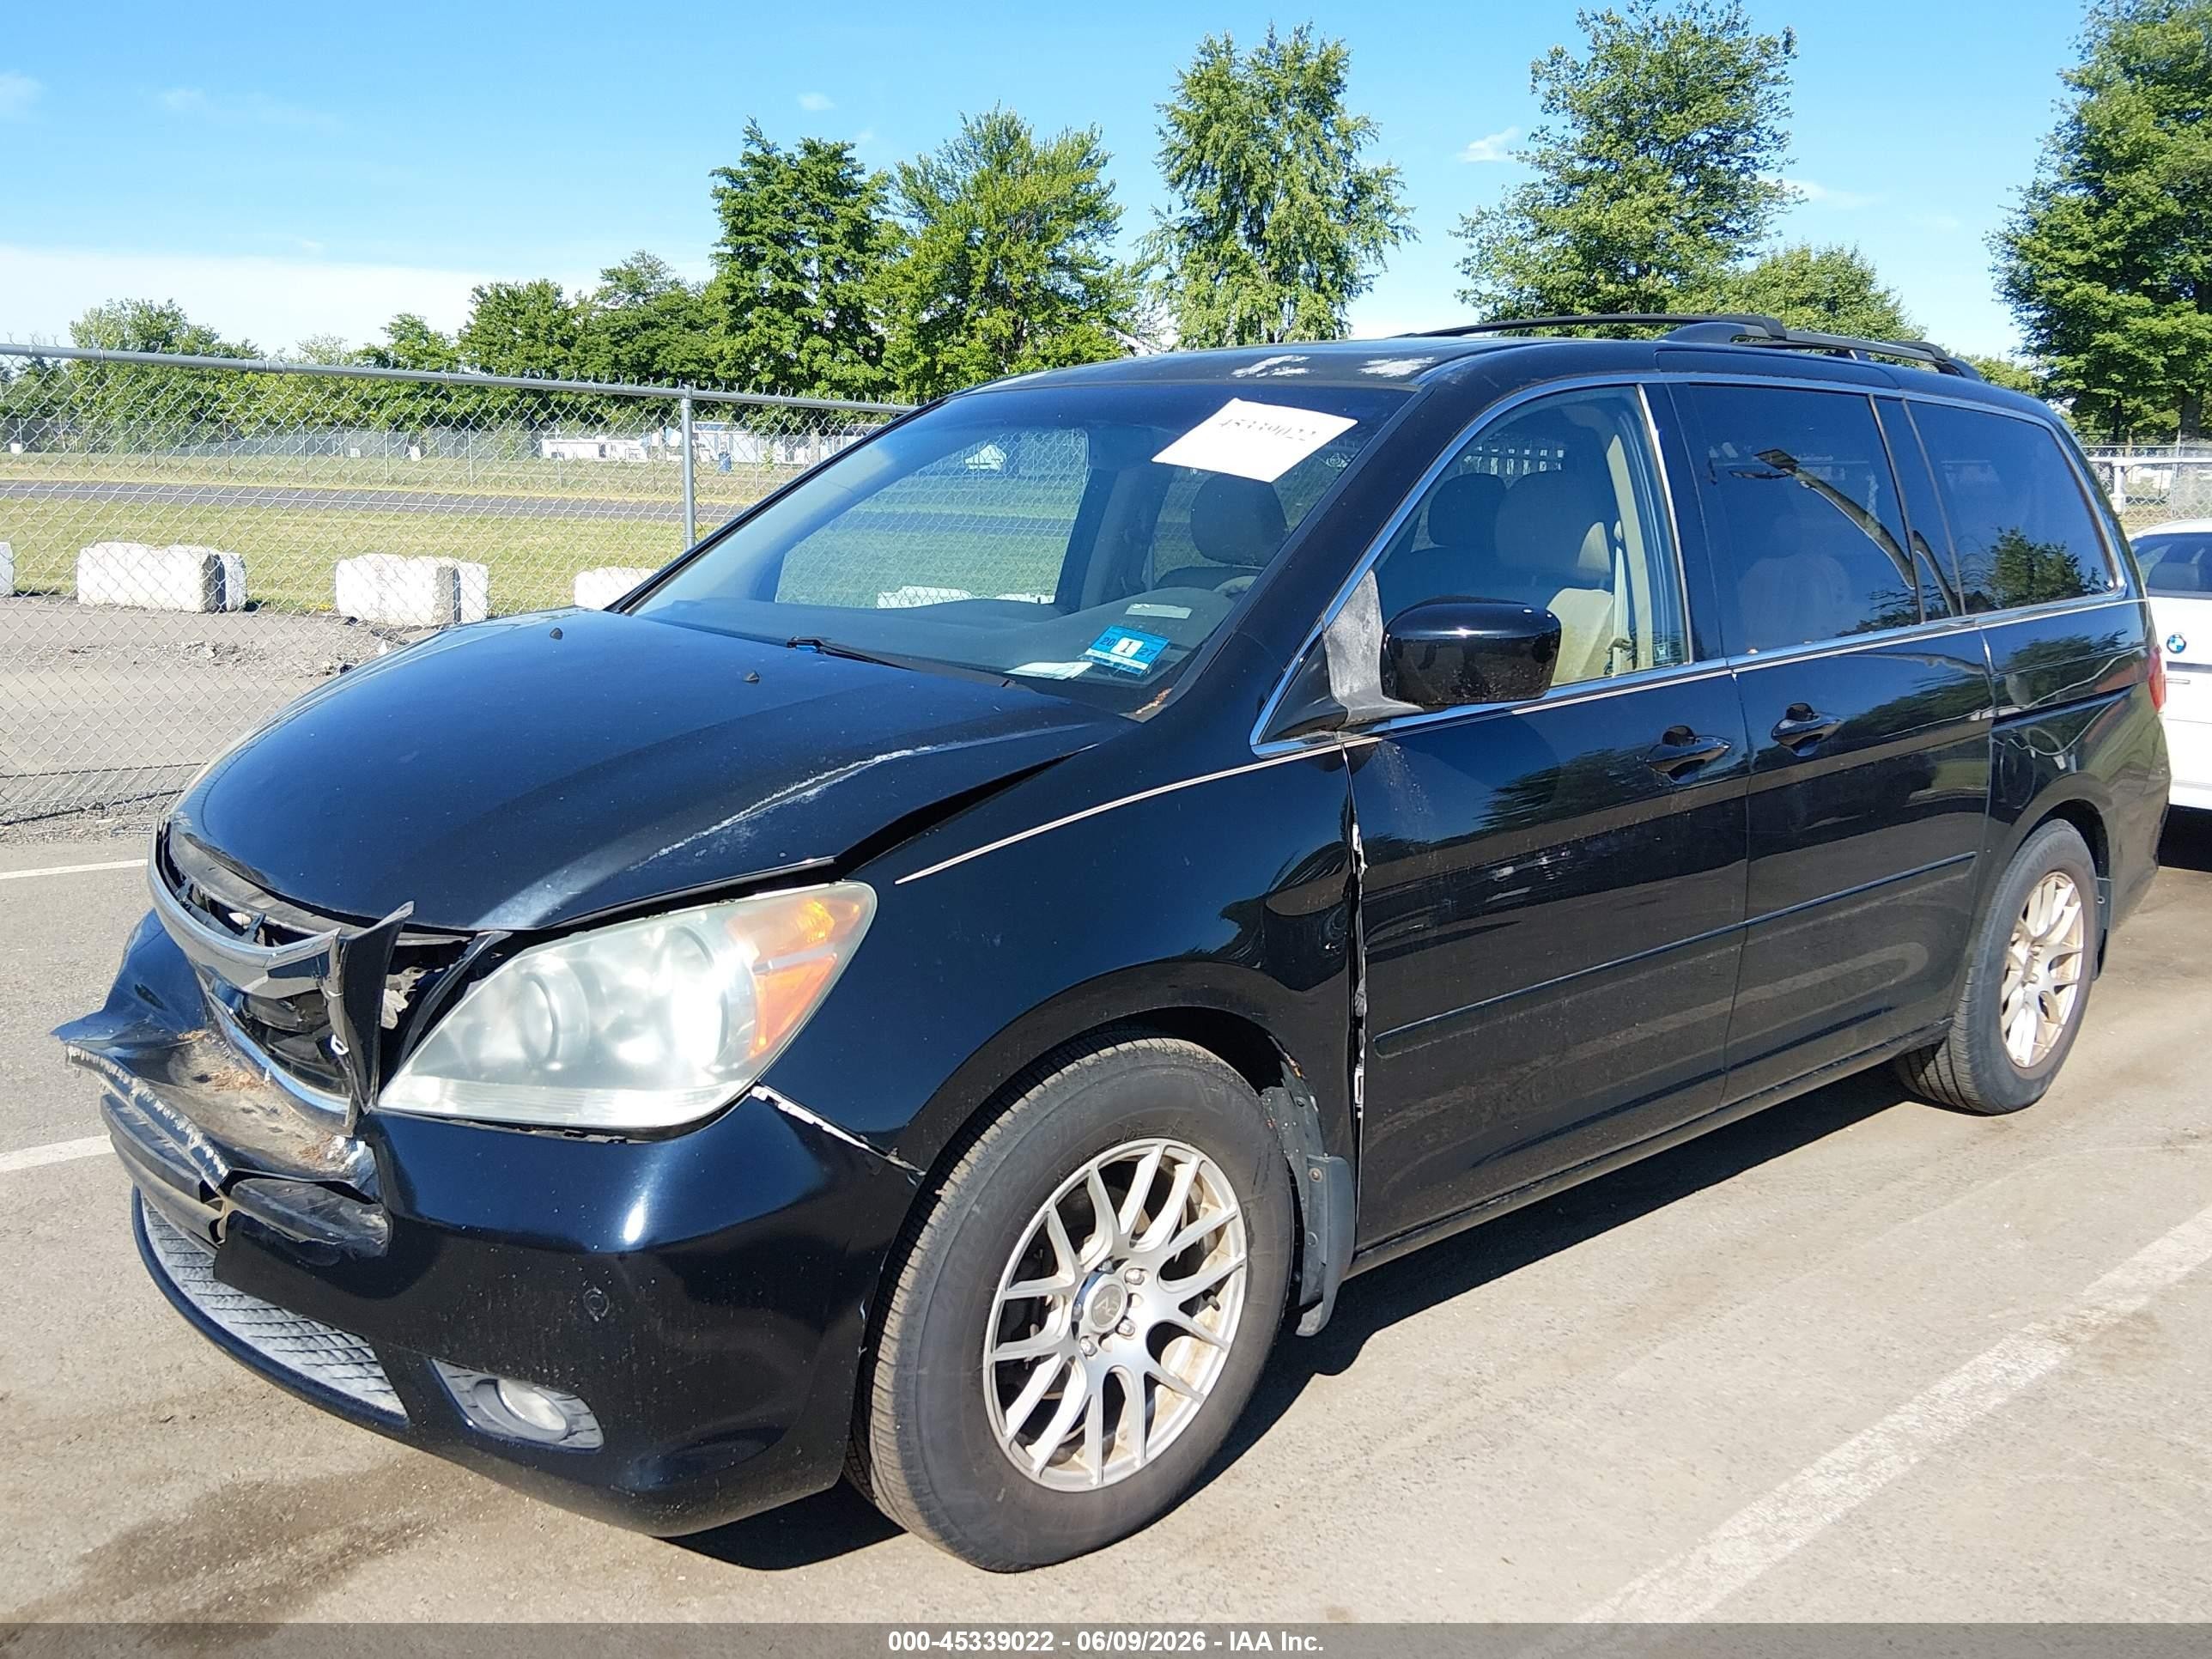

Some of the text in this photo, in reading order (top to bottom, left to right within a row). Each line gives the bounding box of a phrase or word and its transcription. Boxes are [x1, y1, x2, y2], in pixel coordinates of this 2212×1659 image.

[1098, 637, 1116, 647] 20
[1120, 641, 1134, 653] 1
[1138, 647, 1158, 659] 27
